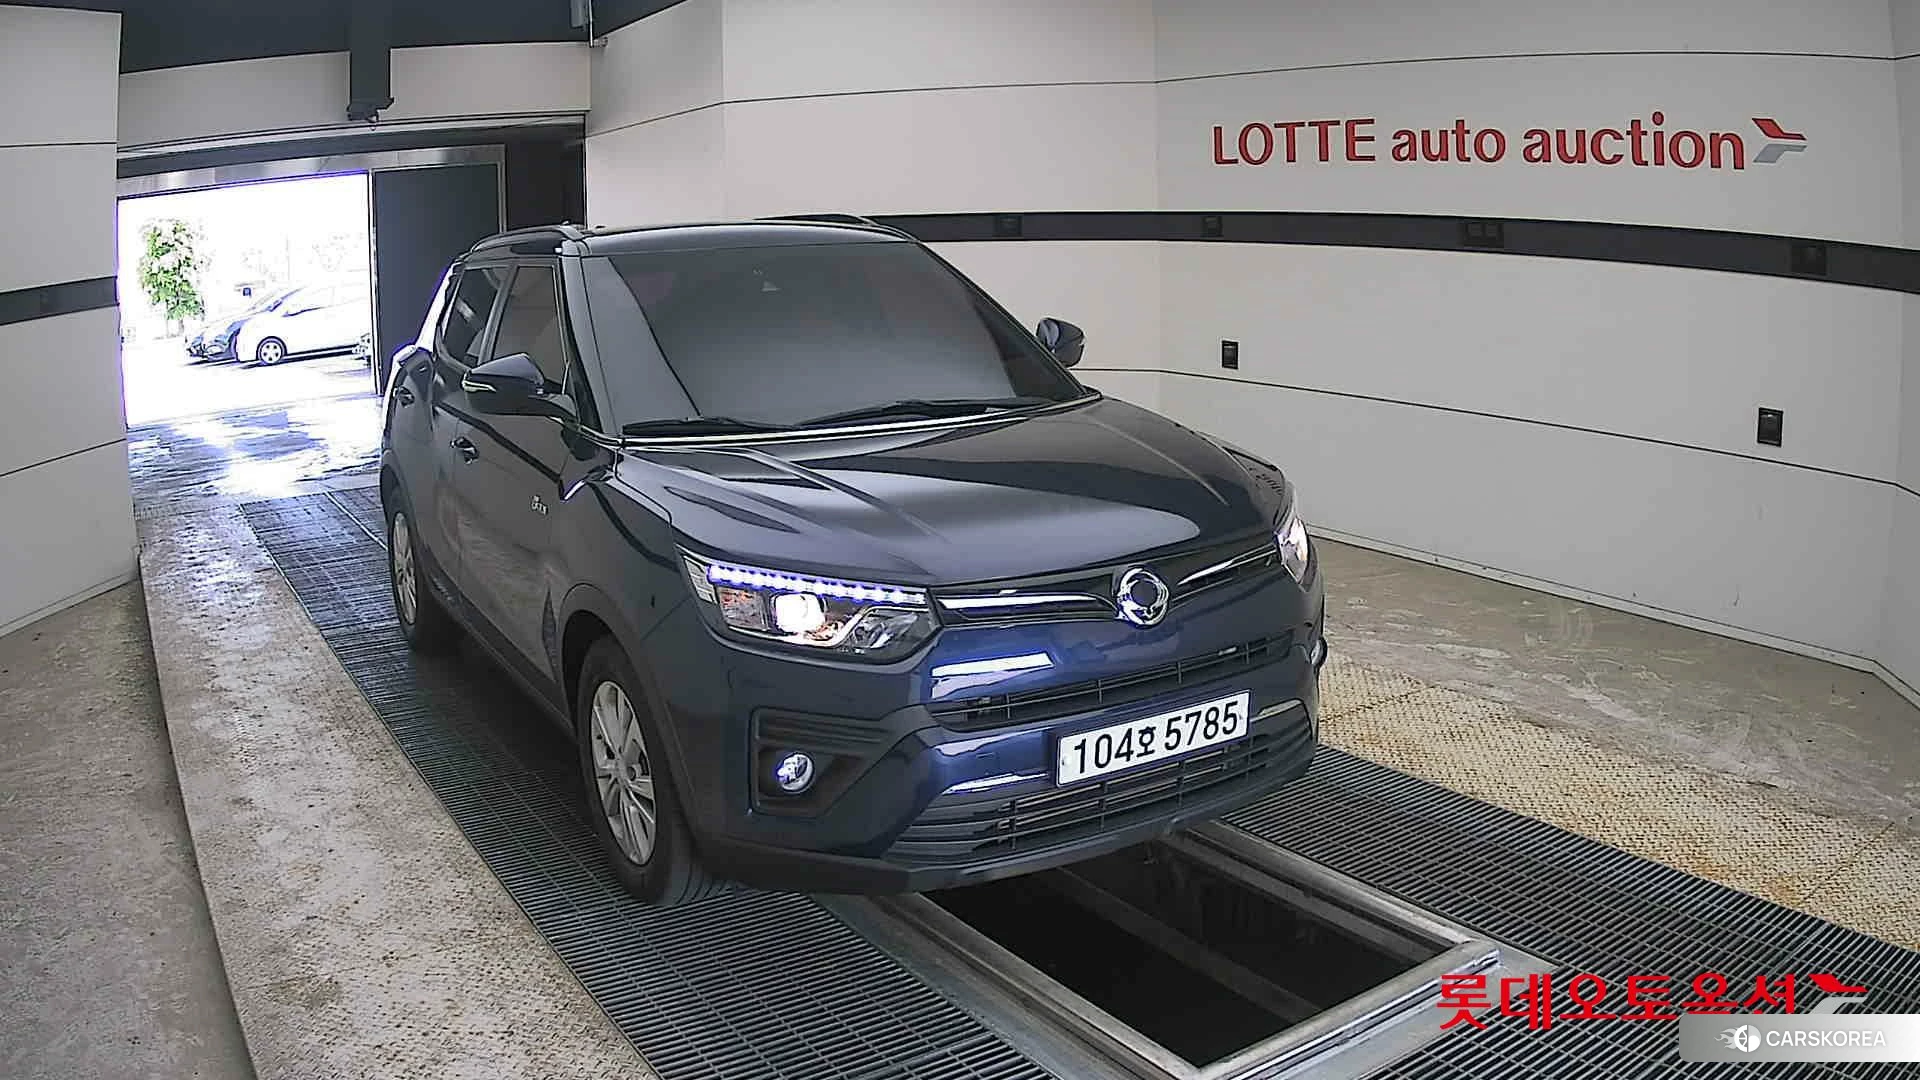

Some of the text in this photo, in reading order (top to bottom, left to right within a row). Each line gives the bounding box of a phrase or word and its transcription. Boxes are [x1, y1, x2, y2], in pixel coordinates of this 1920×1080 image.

[1213, 111, 1745, 170] LOTTE auto auction
[1165, 701, 1238, 751] 5785
